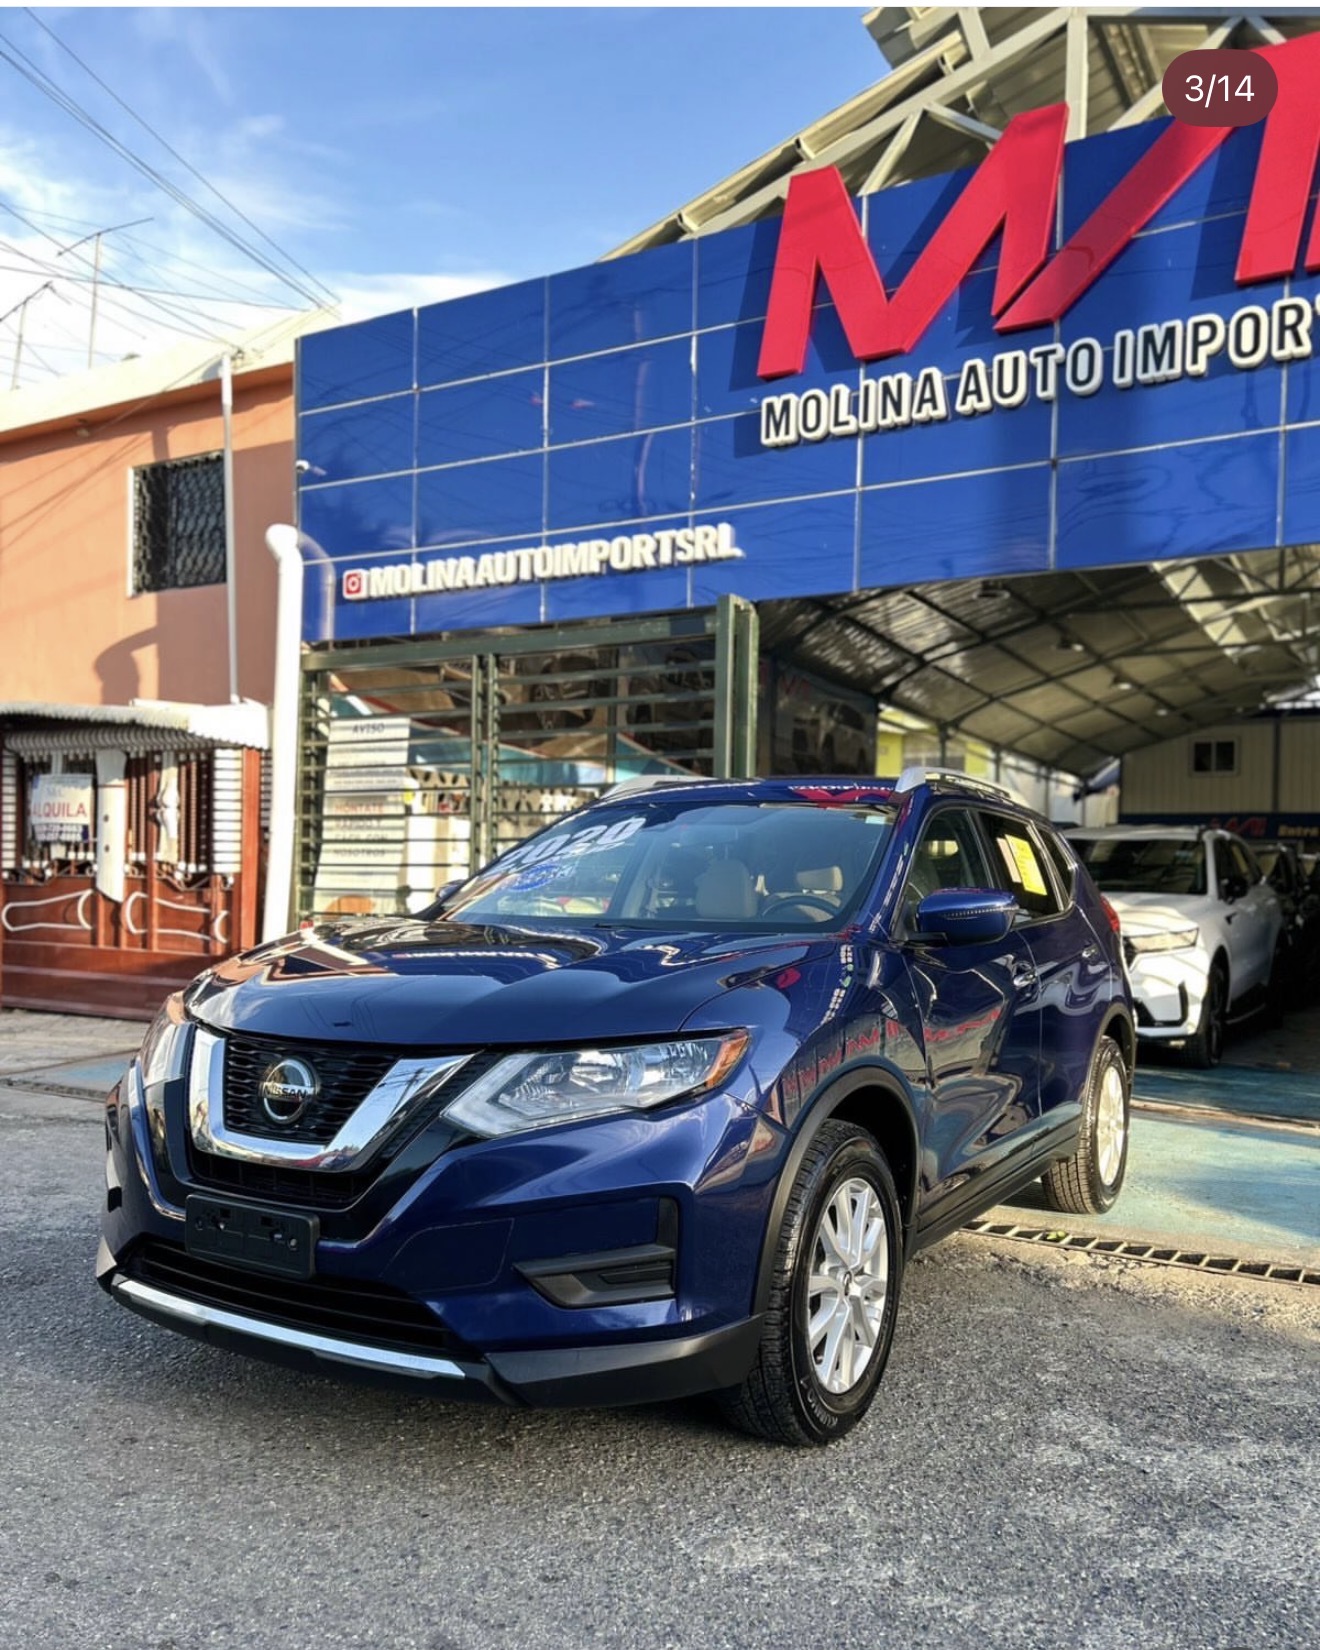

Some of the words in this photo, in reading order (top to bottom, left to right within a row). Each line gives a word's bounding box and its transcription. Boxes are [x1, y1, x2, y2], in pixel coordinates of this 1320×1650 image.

[761, 367, 946, 446] MOLINA
[956, 337, 1104, 416] AUTO
[1113, 294, 1320, 389] IMPOR
[480, 817, 647, 879] 2020
